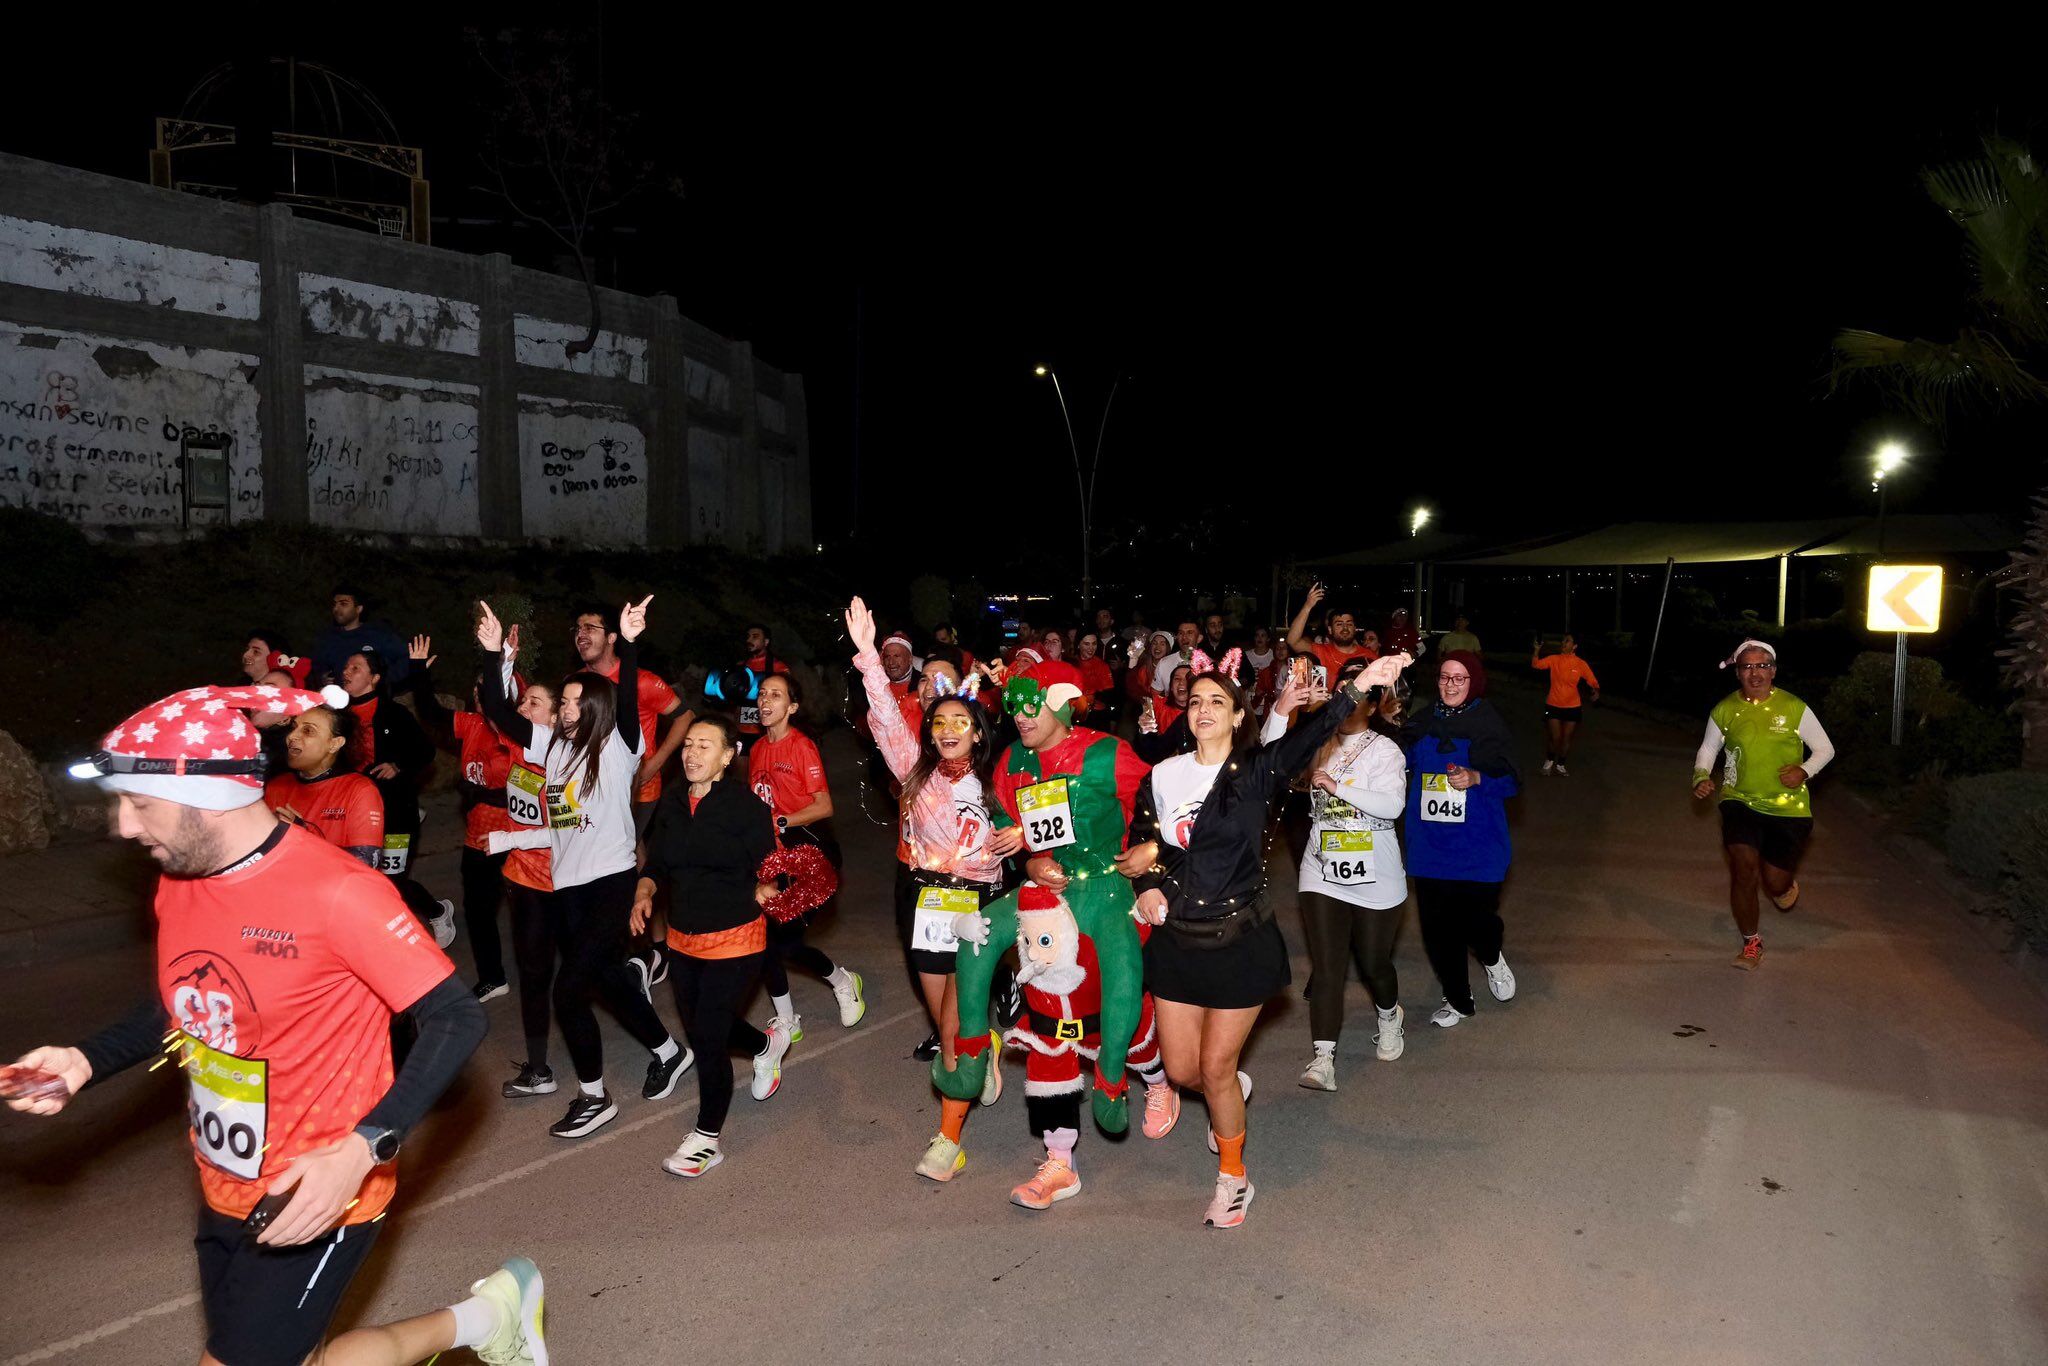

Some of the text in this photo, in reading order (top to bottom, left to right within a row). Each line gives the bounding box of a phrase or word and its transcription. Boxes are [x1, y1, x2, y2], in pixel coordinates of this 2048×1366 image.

[510, 795, 538, 820] 020
[1428, 799, 1462, 817] 048
[1030, 816, 1065, 844] 328
[1331, 861, 1366, 879] 164
[241, 926, 296, 942] ÇUKUROVA
